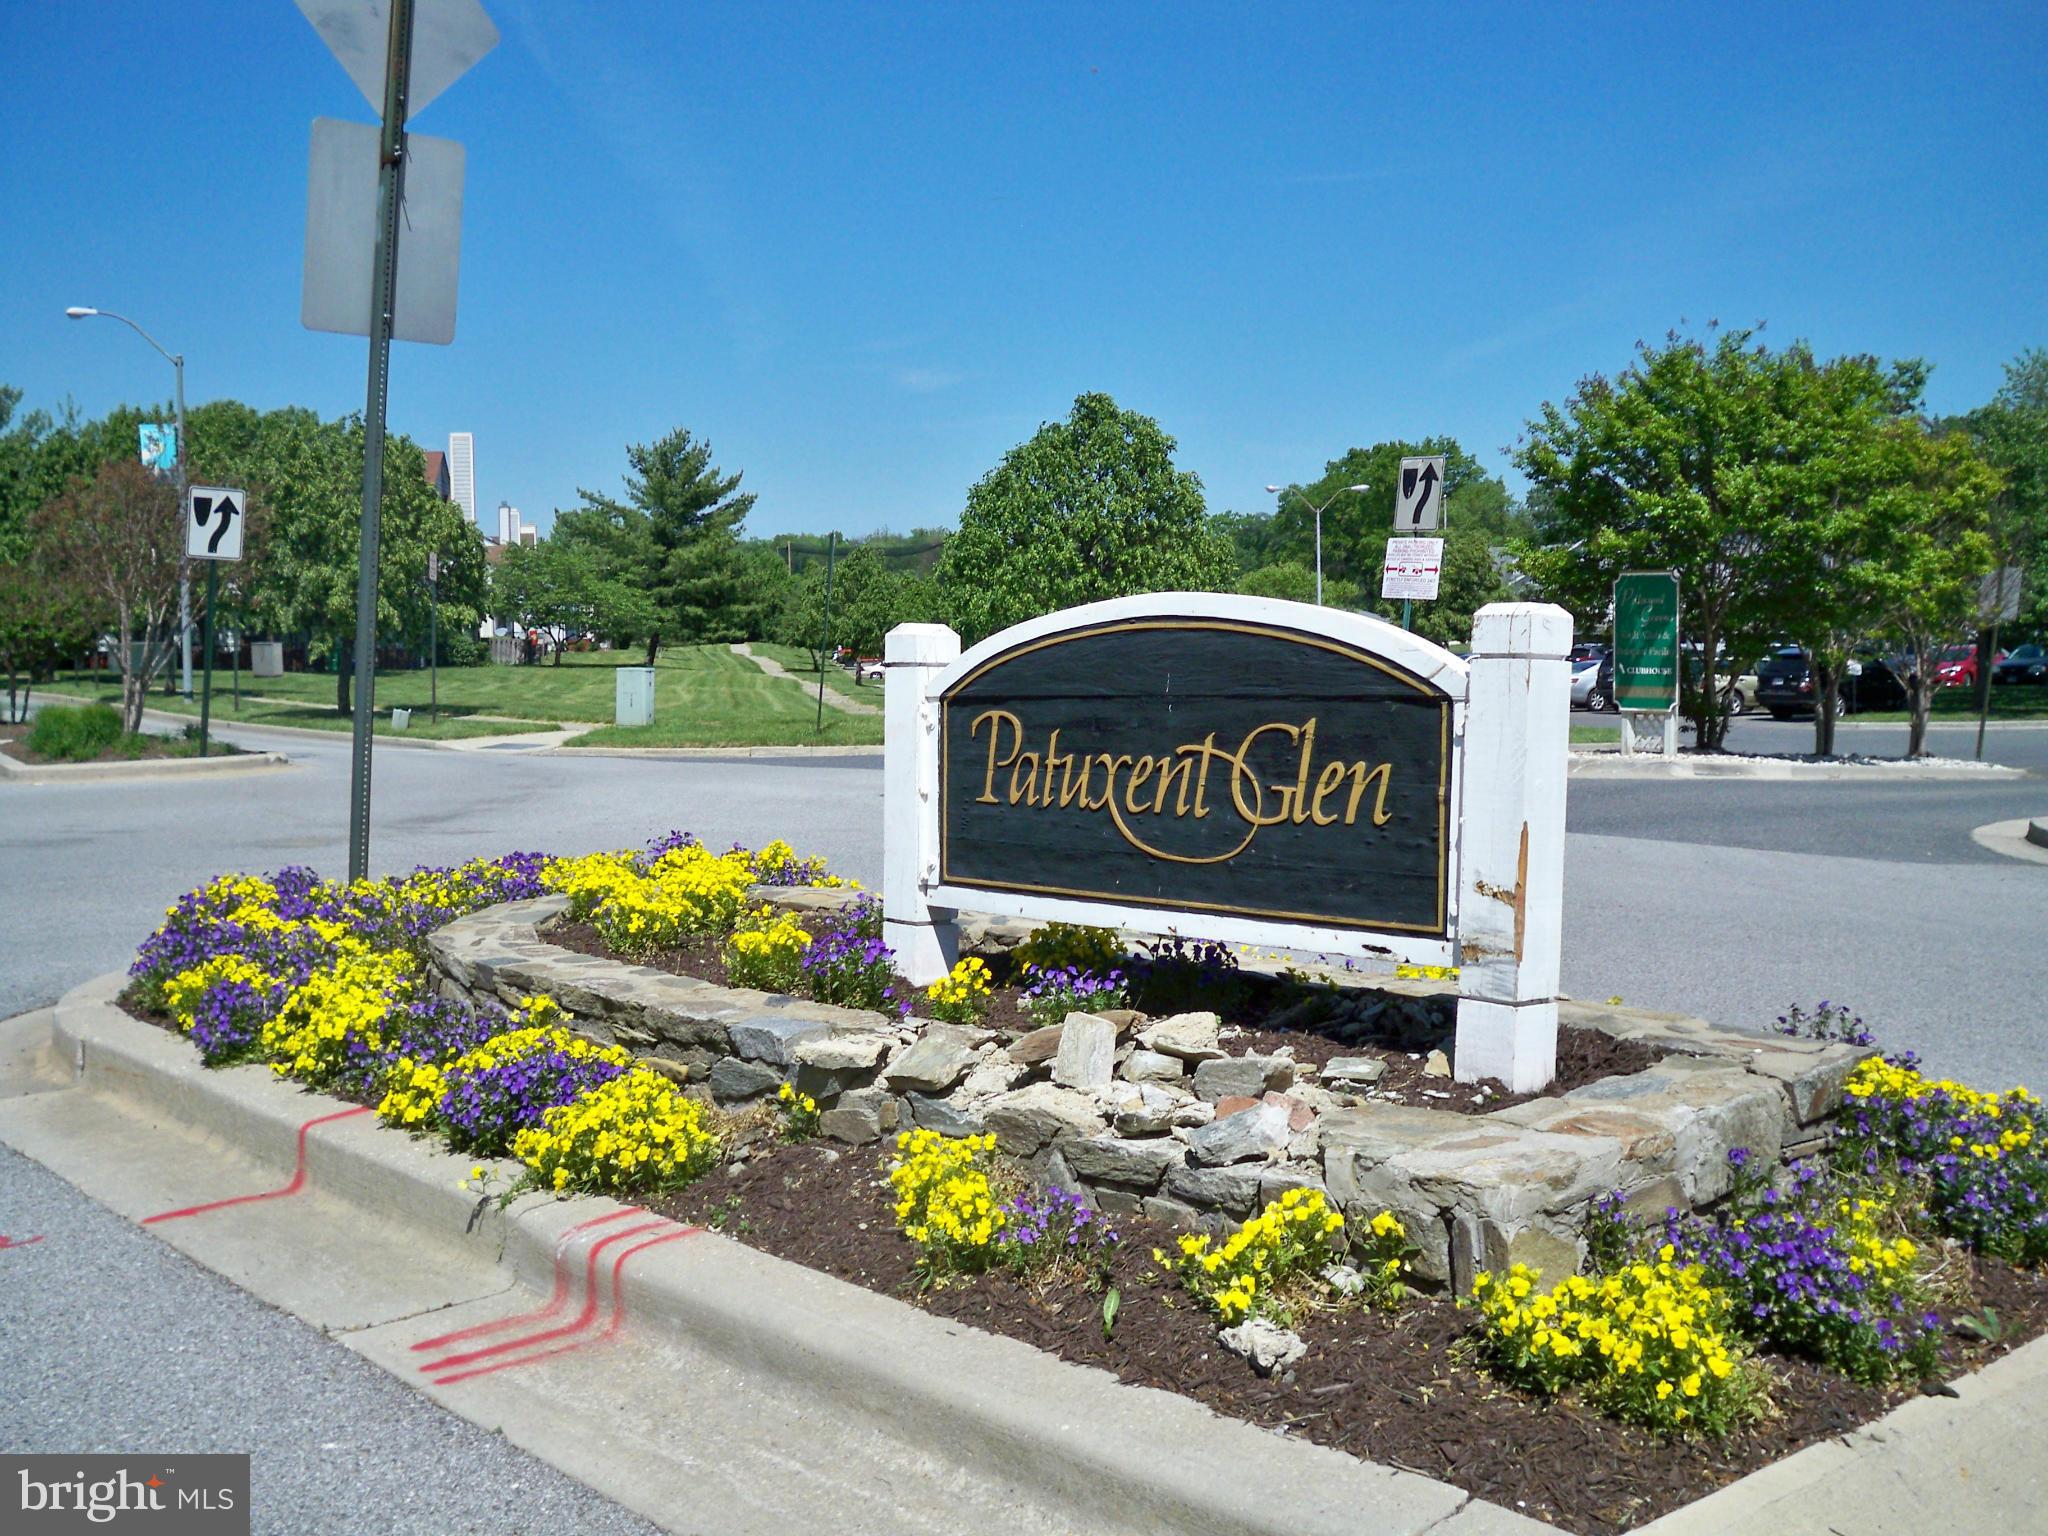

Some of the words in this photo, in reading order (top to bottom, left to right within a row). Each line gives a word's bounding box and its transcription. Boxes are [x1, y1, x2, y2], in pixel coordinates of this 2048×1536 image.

[1626, 666, 1673, 675] CLUBHOUSE
[971, 710, 1261, 863] Patuxent
[1231, 717, 1392, 826] Glen
